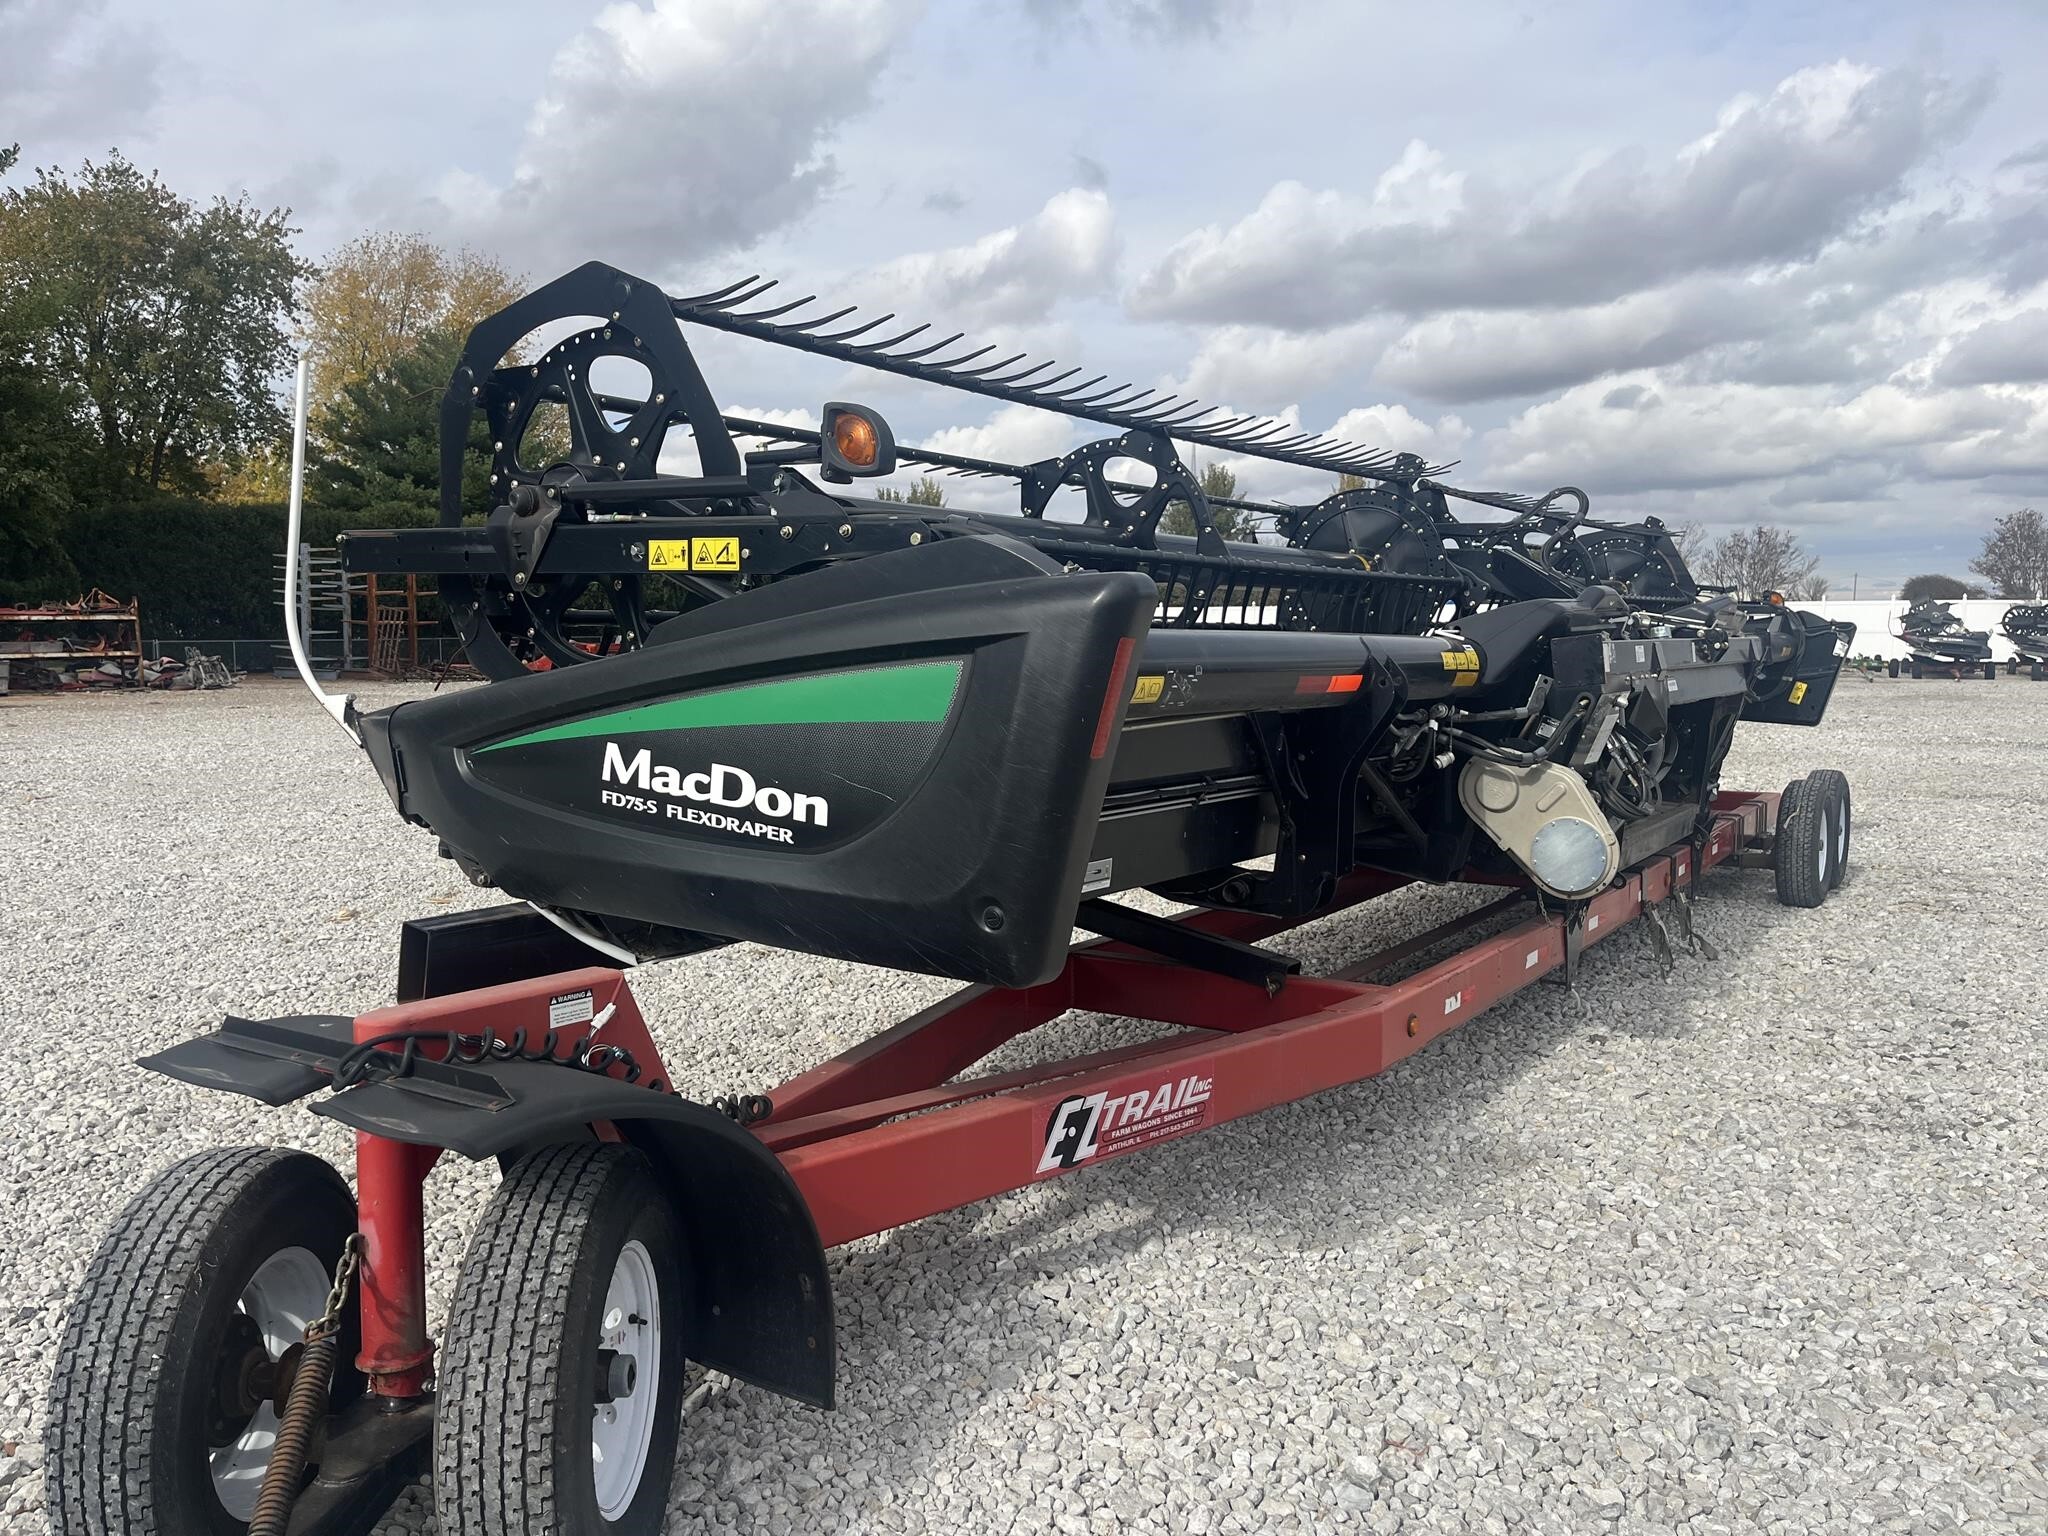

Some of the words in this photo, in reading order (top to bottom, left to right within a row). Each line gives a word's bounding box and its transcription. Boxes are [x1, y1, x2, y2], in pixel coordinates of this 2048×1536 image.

[601, 741, 829, 827] MacDon
[666, 804, 795, 844] FLEXDRAPER
[557, 991, 586, 1003] WARNING
[1101, 1075, 1211, 1131] TRAIL
[1111, 1128, 1131, 1138] FARM
[1132, 1117, 1161, 1132] WAGONS
[1164, 1110, 1183, 1122] SINCE
